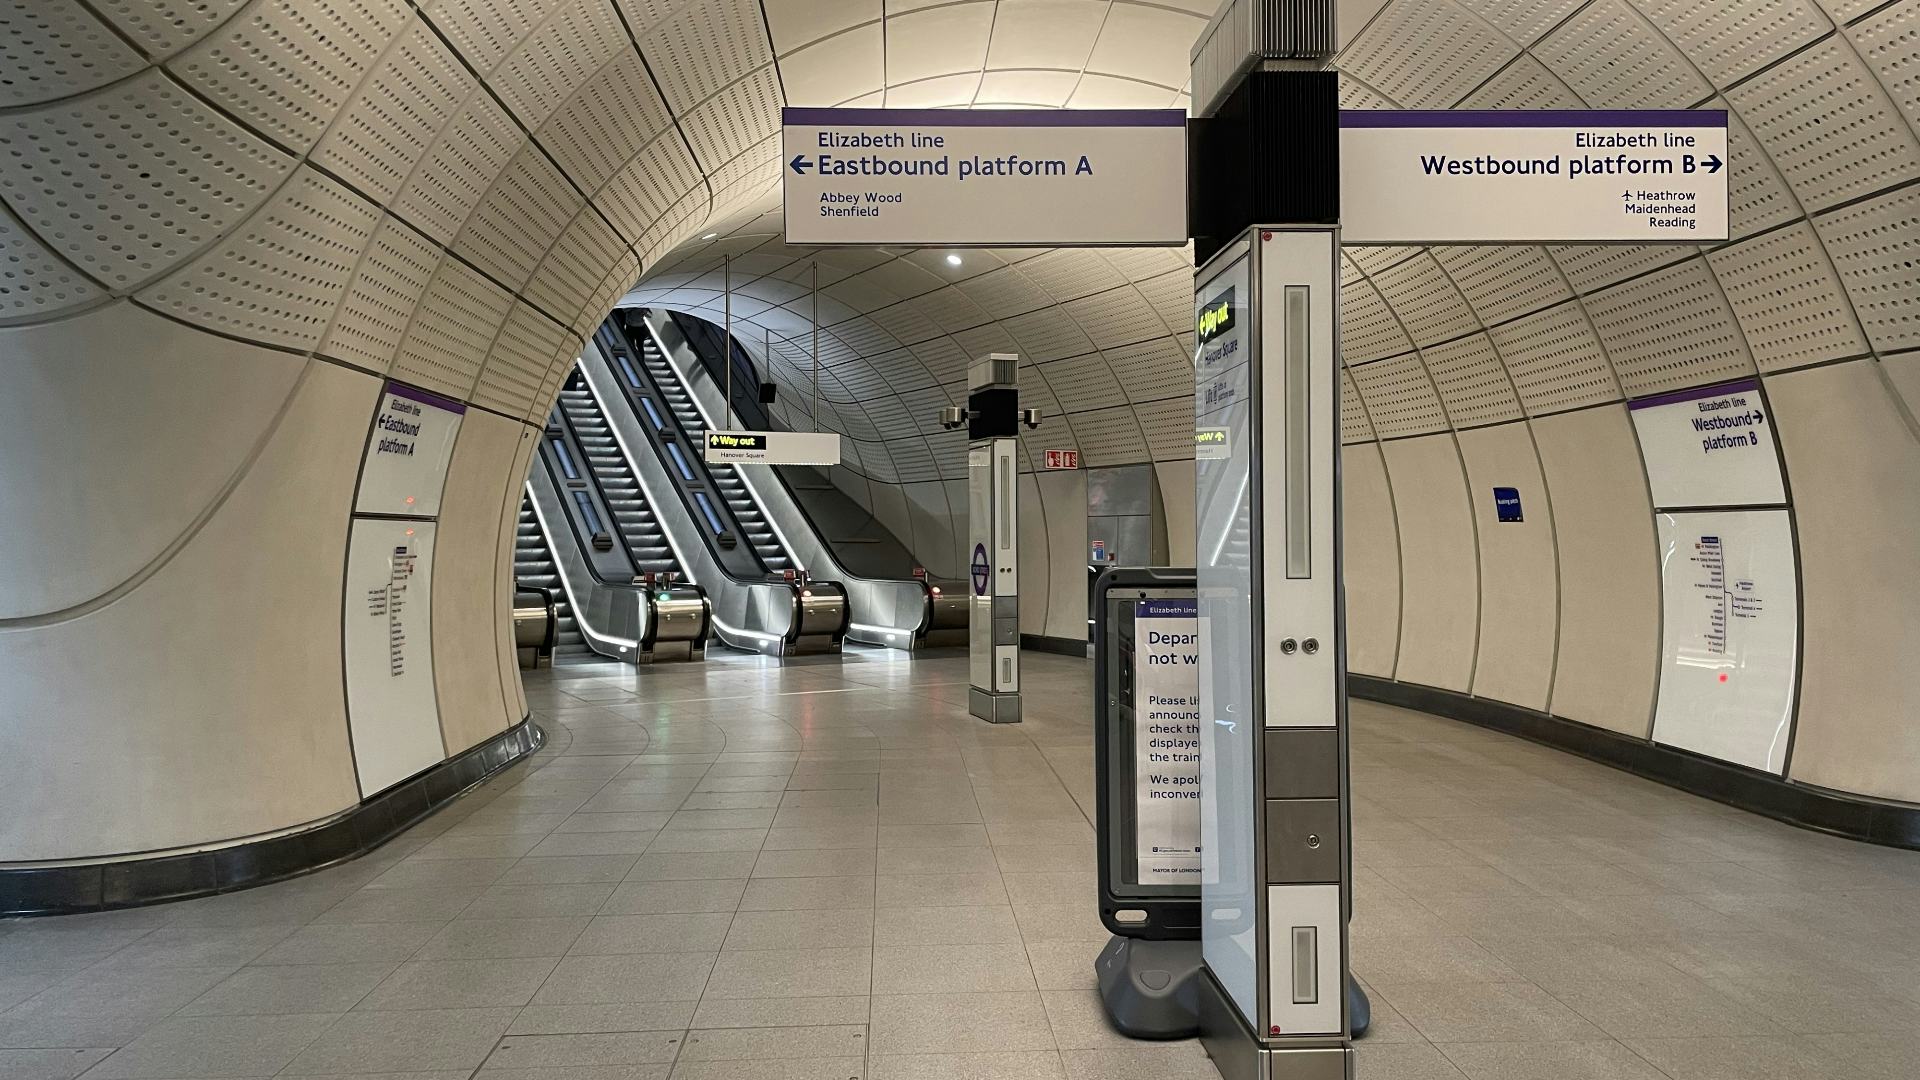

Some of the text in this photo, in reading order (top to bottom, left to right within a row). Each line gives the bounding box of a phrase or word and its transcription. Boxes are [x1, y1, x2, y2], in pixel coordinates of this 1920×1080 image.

[818, 132, 944, 148] Elizabeth line
[1575, 132, 1696, 148] Elizabeth line
[818, 154, 1093, 180] Eastbound platform A
[1420, 155, 1696, 179] Westbound platform B
[819, 192, 902, 206] Abbey Wood
[1636, 190, 1696, 201] Heathrow
[820, 206, 879, 217] Shenfield
[1625, 203, 1696, 214] Maidenhead
[1649, 216, 1696, 229] Reading
[1204, 301, 1229, 333] Way out
[1698, 397, 1747, 412] Elizabeth line
[385, 415, 421, 437] Eastbound
[1691, 410, 1752, 432] Westbound
[377, 436, 415, 456] platform A
[719, 435, 755, 447] Way out
[1703, 431, 1758, 454] platform B
[720, 451, 744, 459] Hanover
[1149, 606, 1197, 614] Elizabeth line
[1149, 652, 1178, 665] not
[1149, 695, 1186, 705] Please
[1149, 724, 1183, 734] check
[1149, 752, 1170, 762] the
[1149, 774, 1170, 785] We
